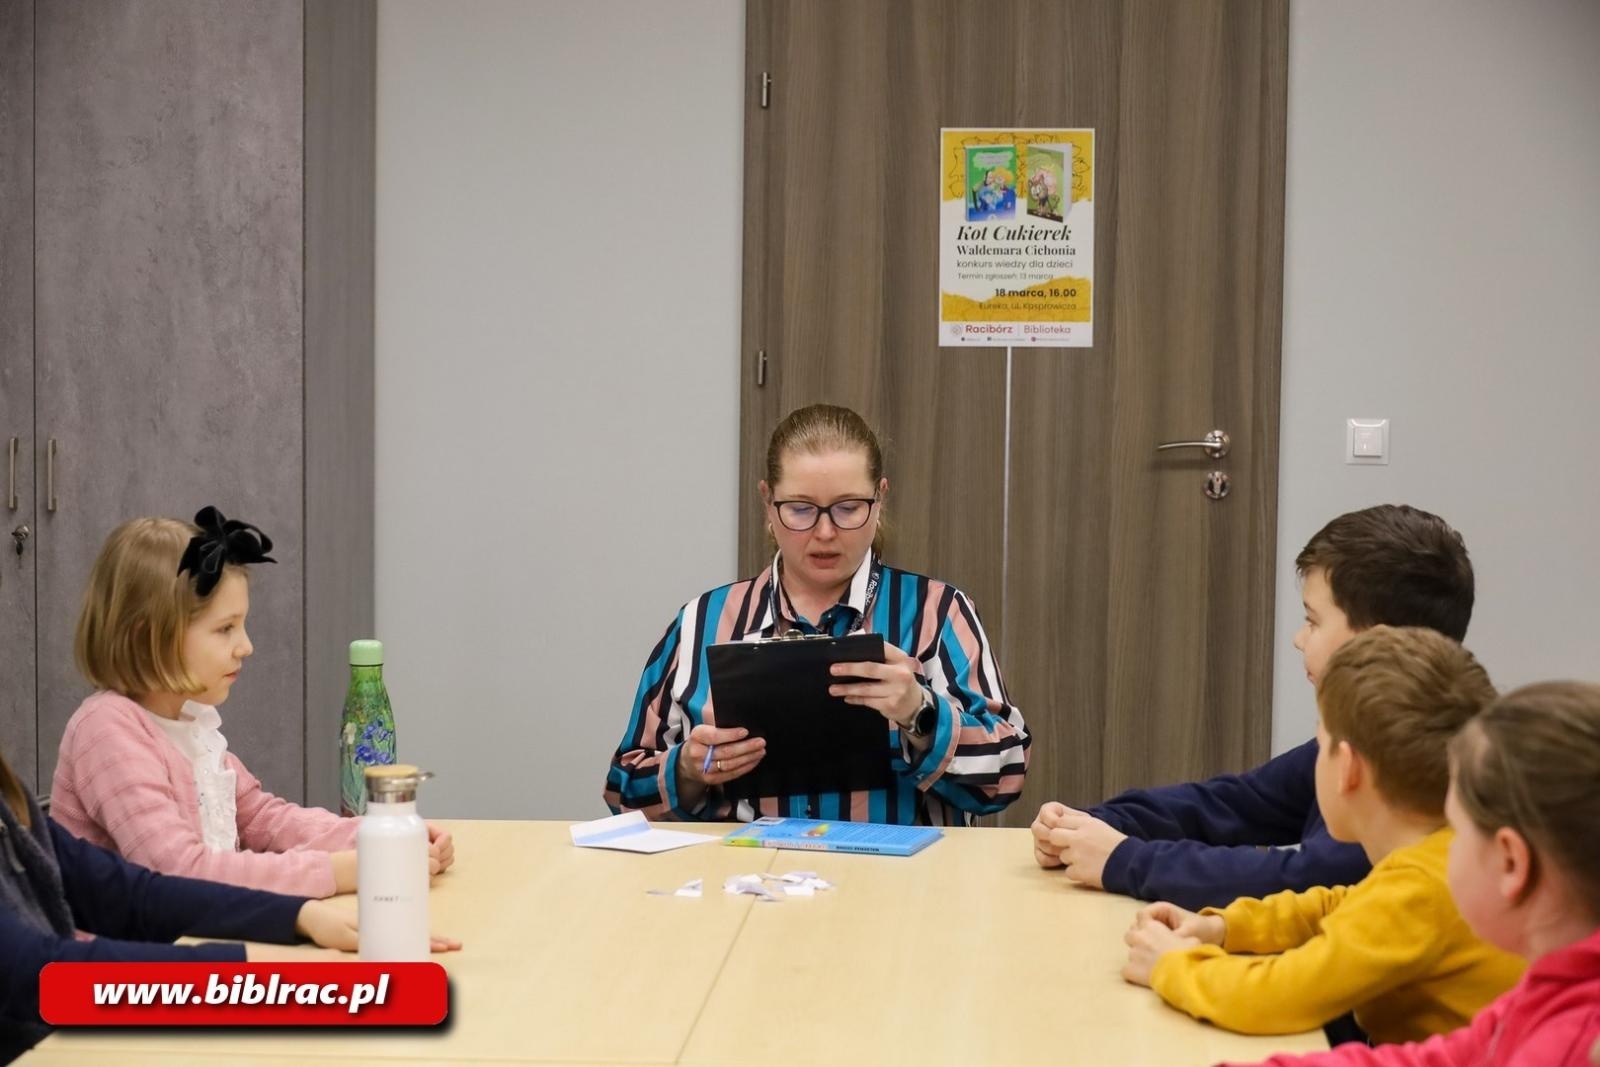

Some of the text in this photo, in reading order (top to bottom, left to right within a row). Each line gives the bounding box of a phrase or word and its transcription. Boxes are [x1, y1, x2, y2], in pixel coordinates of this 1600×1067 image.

[956, 225, 1072, 241] Kot Cukierek
[957, 244, 1076, 256] Waldemara Cichonia
[957, 259, 1073, 270] konkurs wiedzy dla dzieci
[958, 272, 984, 280] Termin
[995, 288, 1077, 299] 18 marca, 16.00
[965, 324, 1071, 334] Racibórz Biblioteka
